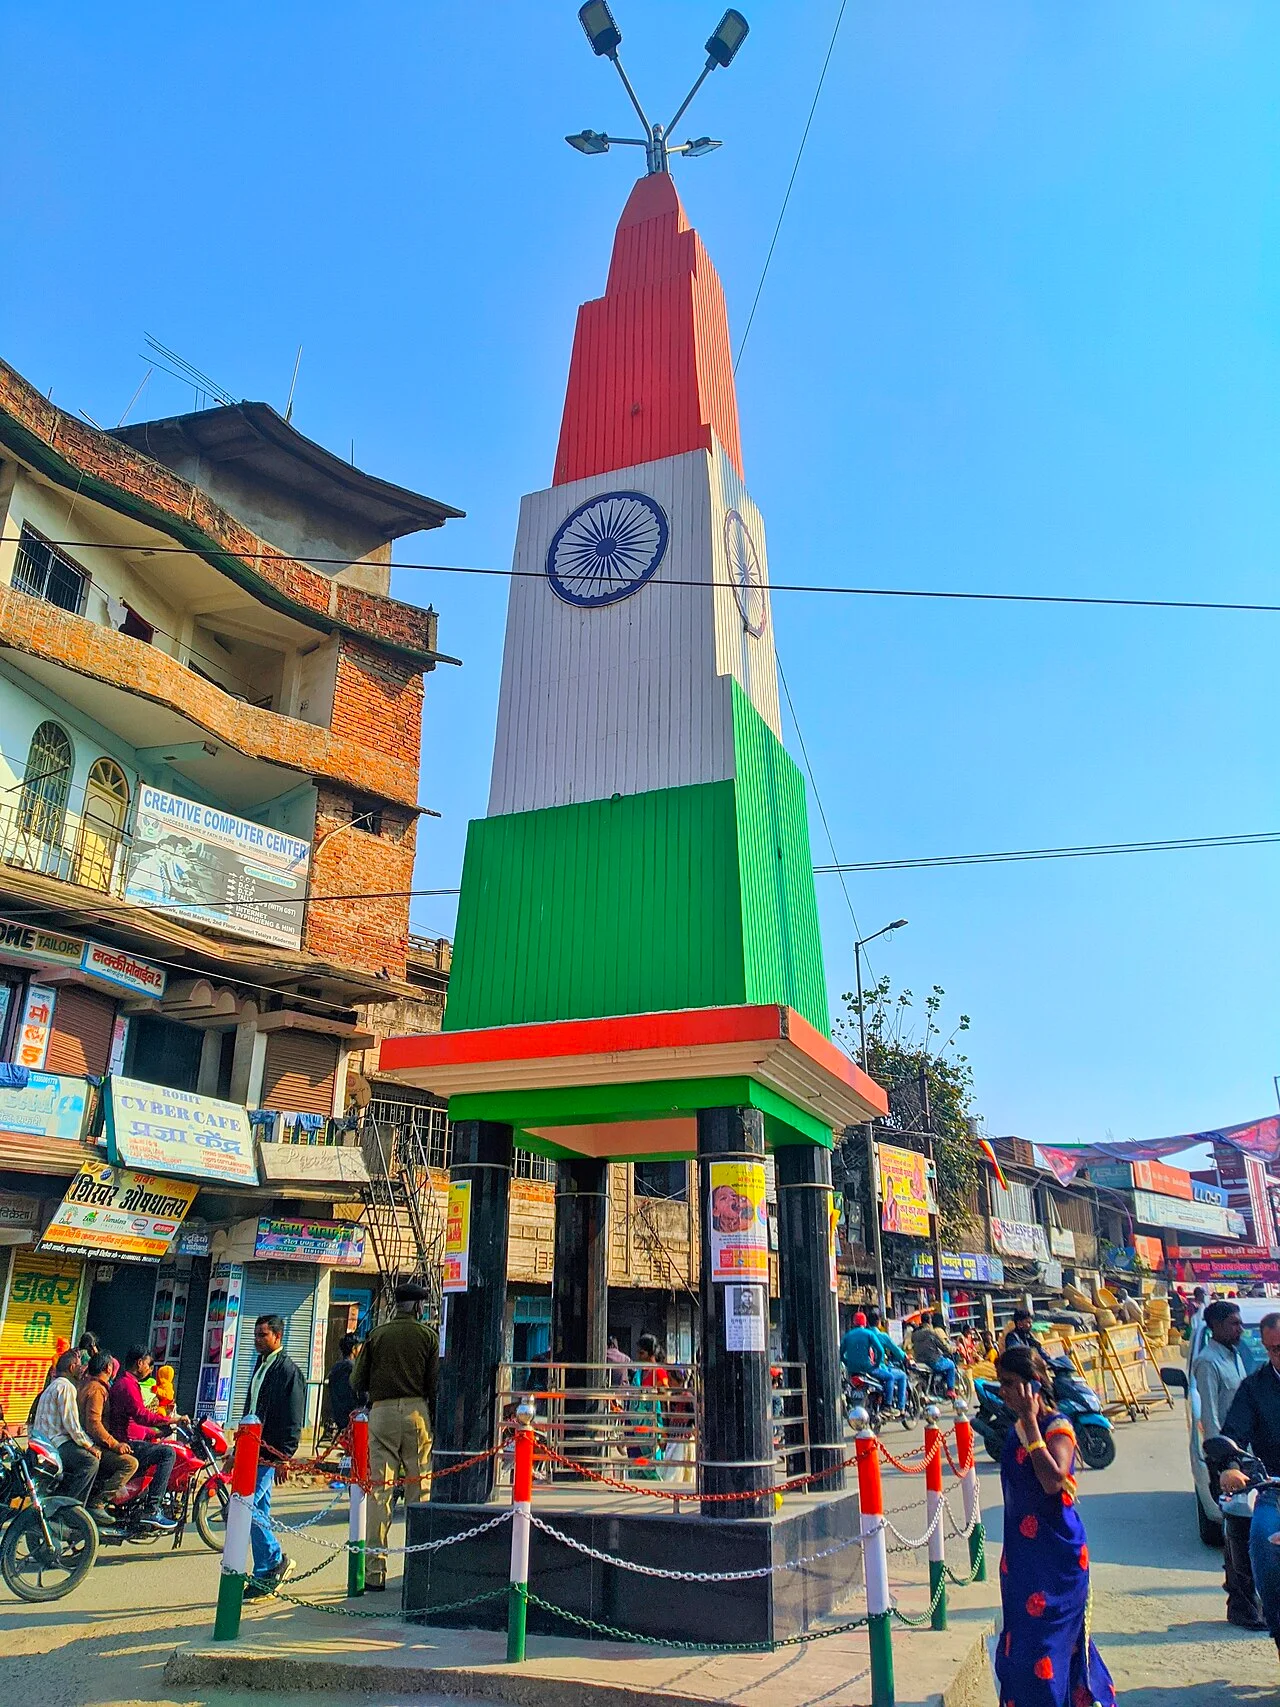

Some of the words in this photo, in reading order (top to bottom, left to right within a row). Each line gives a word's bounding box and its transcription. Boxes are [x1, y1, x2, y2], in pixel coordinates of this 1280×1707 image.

[143, 789, 201, 824] CREATIVE
[204, 810, 264, 846] COMPUTER
[266, 832, 307, 860] CENTER
[236, 906, 268, 919] INTERNET
[37, 935, 81, 955] TAILORS
[162, 1088, 201, 1105] ROHIT
[121, 1096, 190, 1121] CYBER
[193, 1111, 241, 1132] CAFE
[128, 1120, 187, 1143] प्रज्ञा
[193, 1129, 243, 1155] केंद्र
[133, 1173, 157, 1185] डाबर
[1091, 1166, 1128, 1177] ASUS
[70, 1174, 119, 1207] शिखर
[119, 1184, 188, 1218] औषधालय
[1193, 1186, 1222, 1206] LLOYD
[102, 1214, 127, 1225] Himalaya
[12, 1271, 78, 1305] डाबर
